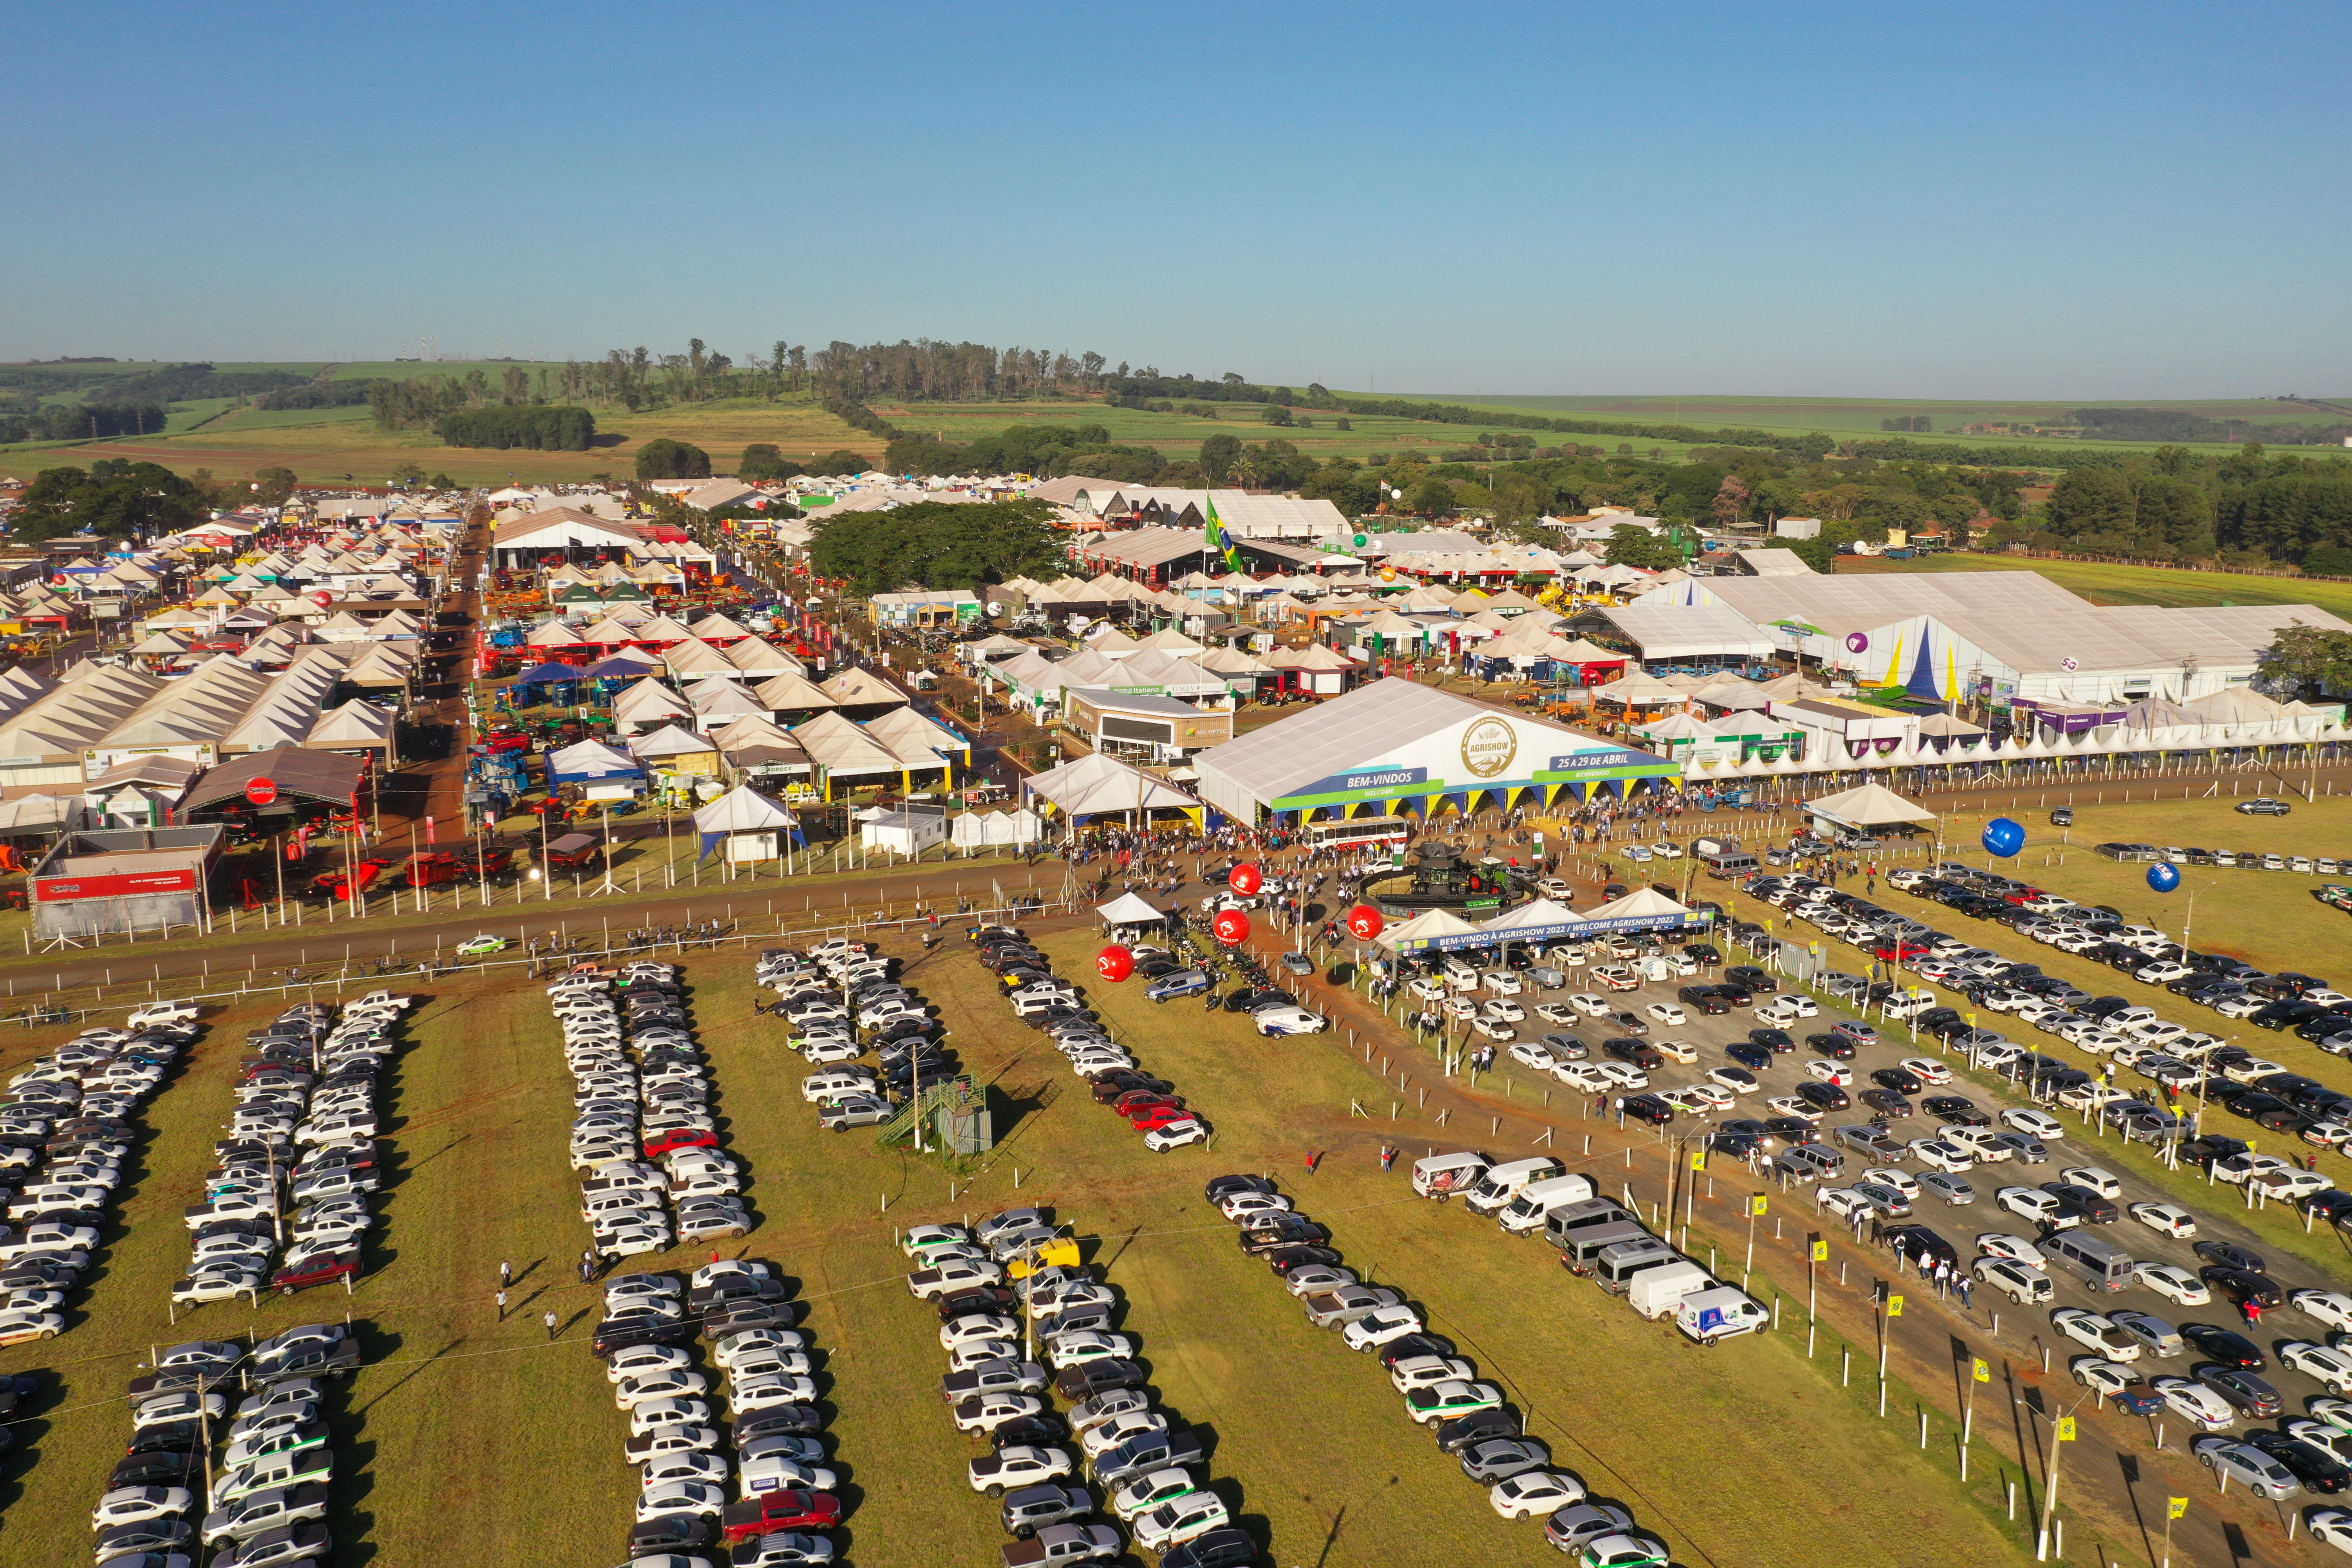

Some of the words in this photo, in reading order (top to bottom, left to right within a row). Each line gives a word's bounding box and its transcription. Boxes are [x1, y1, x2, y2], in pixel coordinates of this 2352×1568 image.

[2061, 657, 2076, 670] 5G
[1078, 709, 1094, 723] SOLINFTEC
[1470, 742, 1508, 752] AGRISHOW
[1557, 758, 1569, 768] 25
[1577, 756, 1588, 767] 29
[1590, 757, 1601, 766] DE
[1603, 754, 1629, 764] ABRIL
[1347, 772, 1412, 788] BEM-VINDOS
[1364, 788, 1394, 797] WELCOME
[1467, 899, 1502, 907] FENDT
[1440, 934, 1489, 946] BEM-VINDO
[1491, 932, 1497, 941] À
[1498, 927, 1544, 939] AGRISHOW
[1573, 921, 1611, 931] WELCOME
[1613, 919, 1655, 928] AGRISHOW
[1655, 916, 1674, 925] 2022
